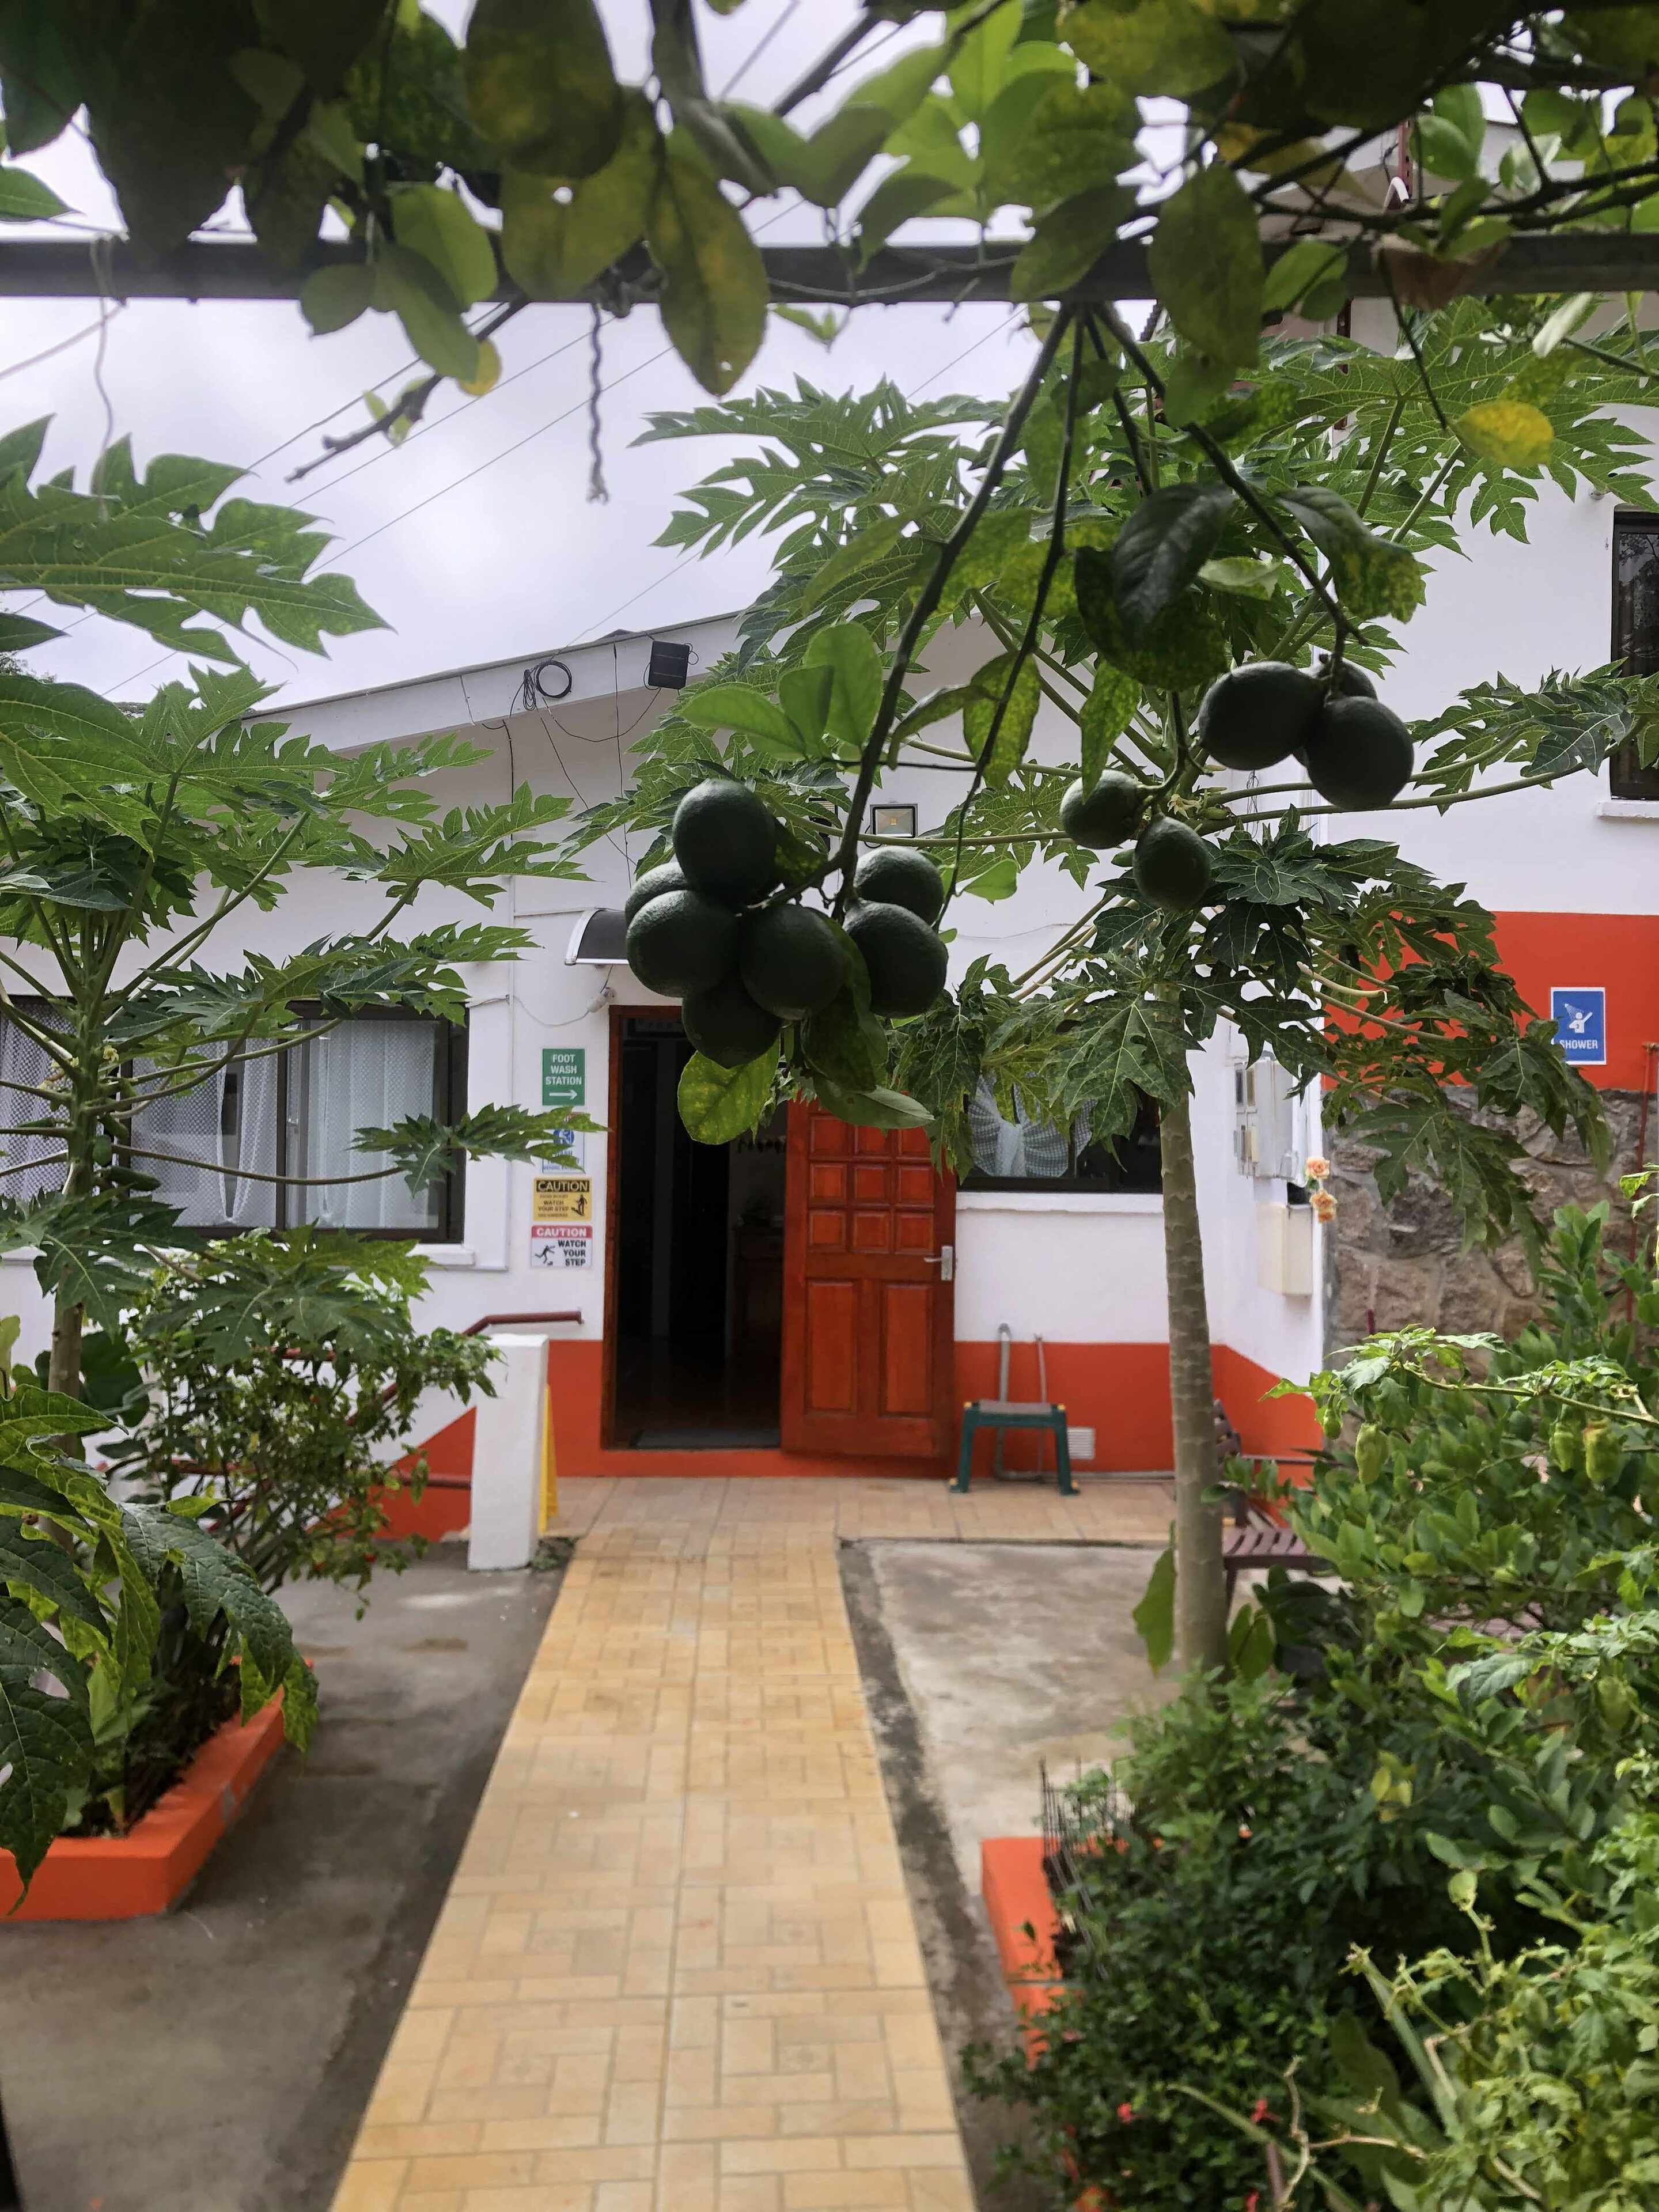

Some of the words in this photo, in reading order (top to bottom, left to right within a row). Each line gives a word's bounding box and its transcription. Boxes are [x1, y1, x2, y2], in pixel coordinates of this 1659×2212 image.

[1559, 1040, 1598, 1049] SHOWER
[553, 1054, 575, 1063] FOOT
[551, 1065, 577, 1074] WASH
[546, 1076, 582, 1085] STATION
[538, 1181, 588, 1191] CAUTION
[536, 1228, 586, 1237] CAUTION
